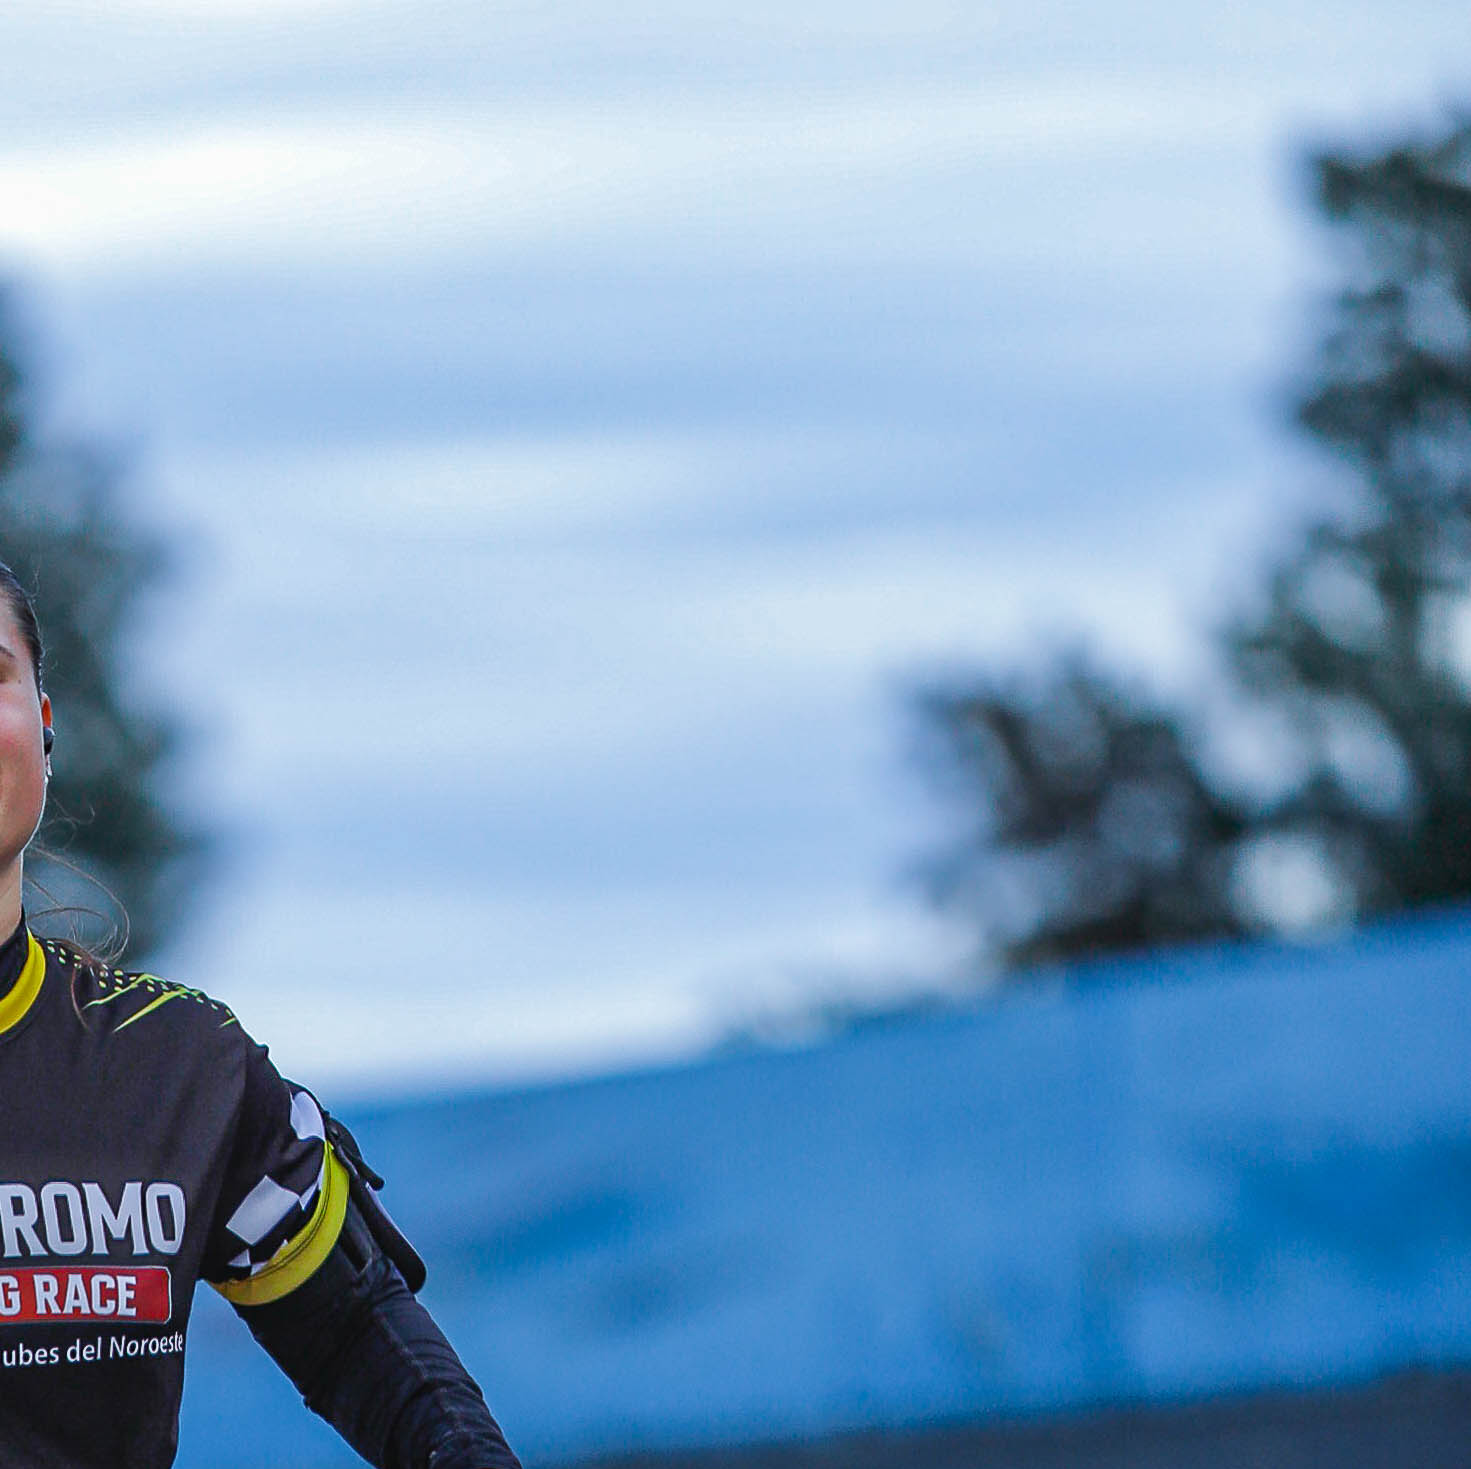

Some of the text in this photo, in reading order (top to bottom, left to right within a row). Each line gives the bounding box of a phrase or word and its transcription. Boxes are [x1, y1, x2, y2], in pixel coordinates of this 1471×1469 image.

[32, 1273, 138, 1318] RACE
[66, 1336, 102, 1362] del
[109, 1331, 184, 1359] Noroeste
